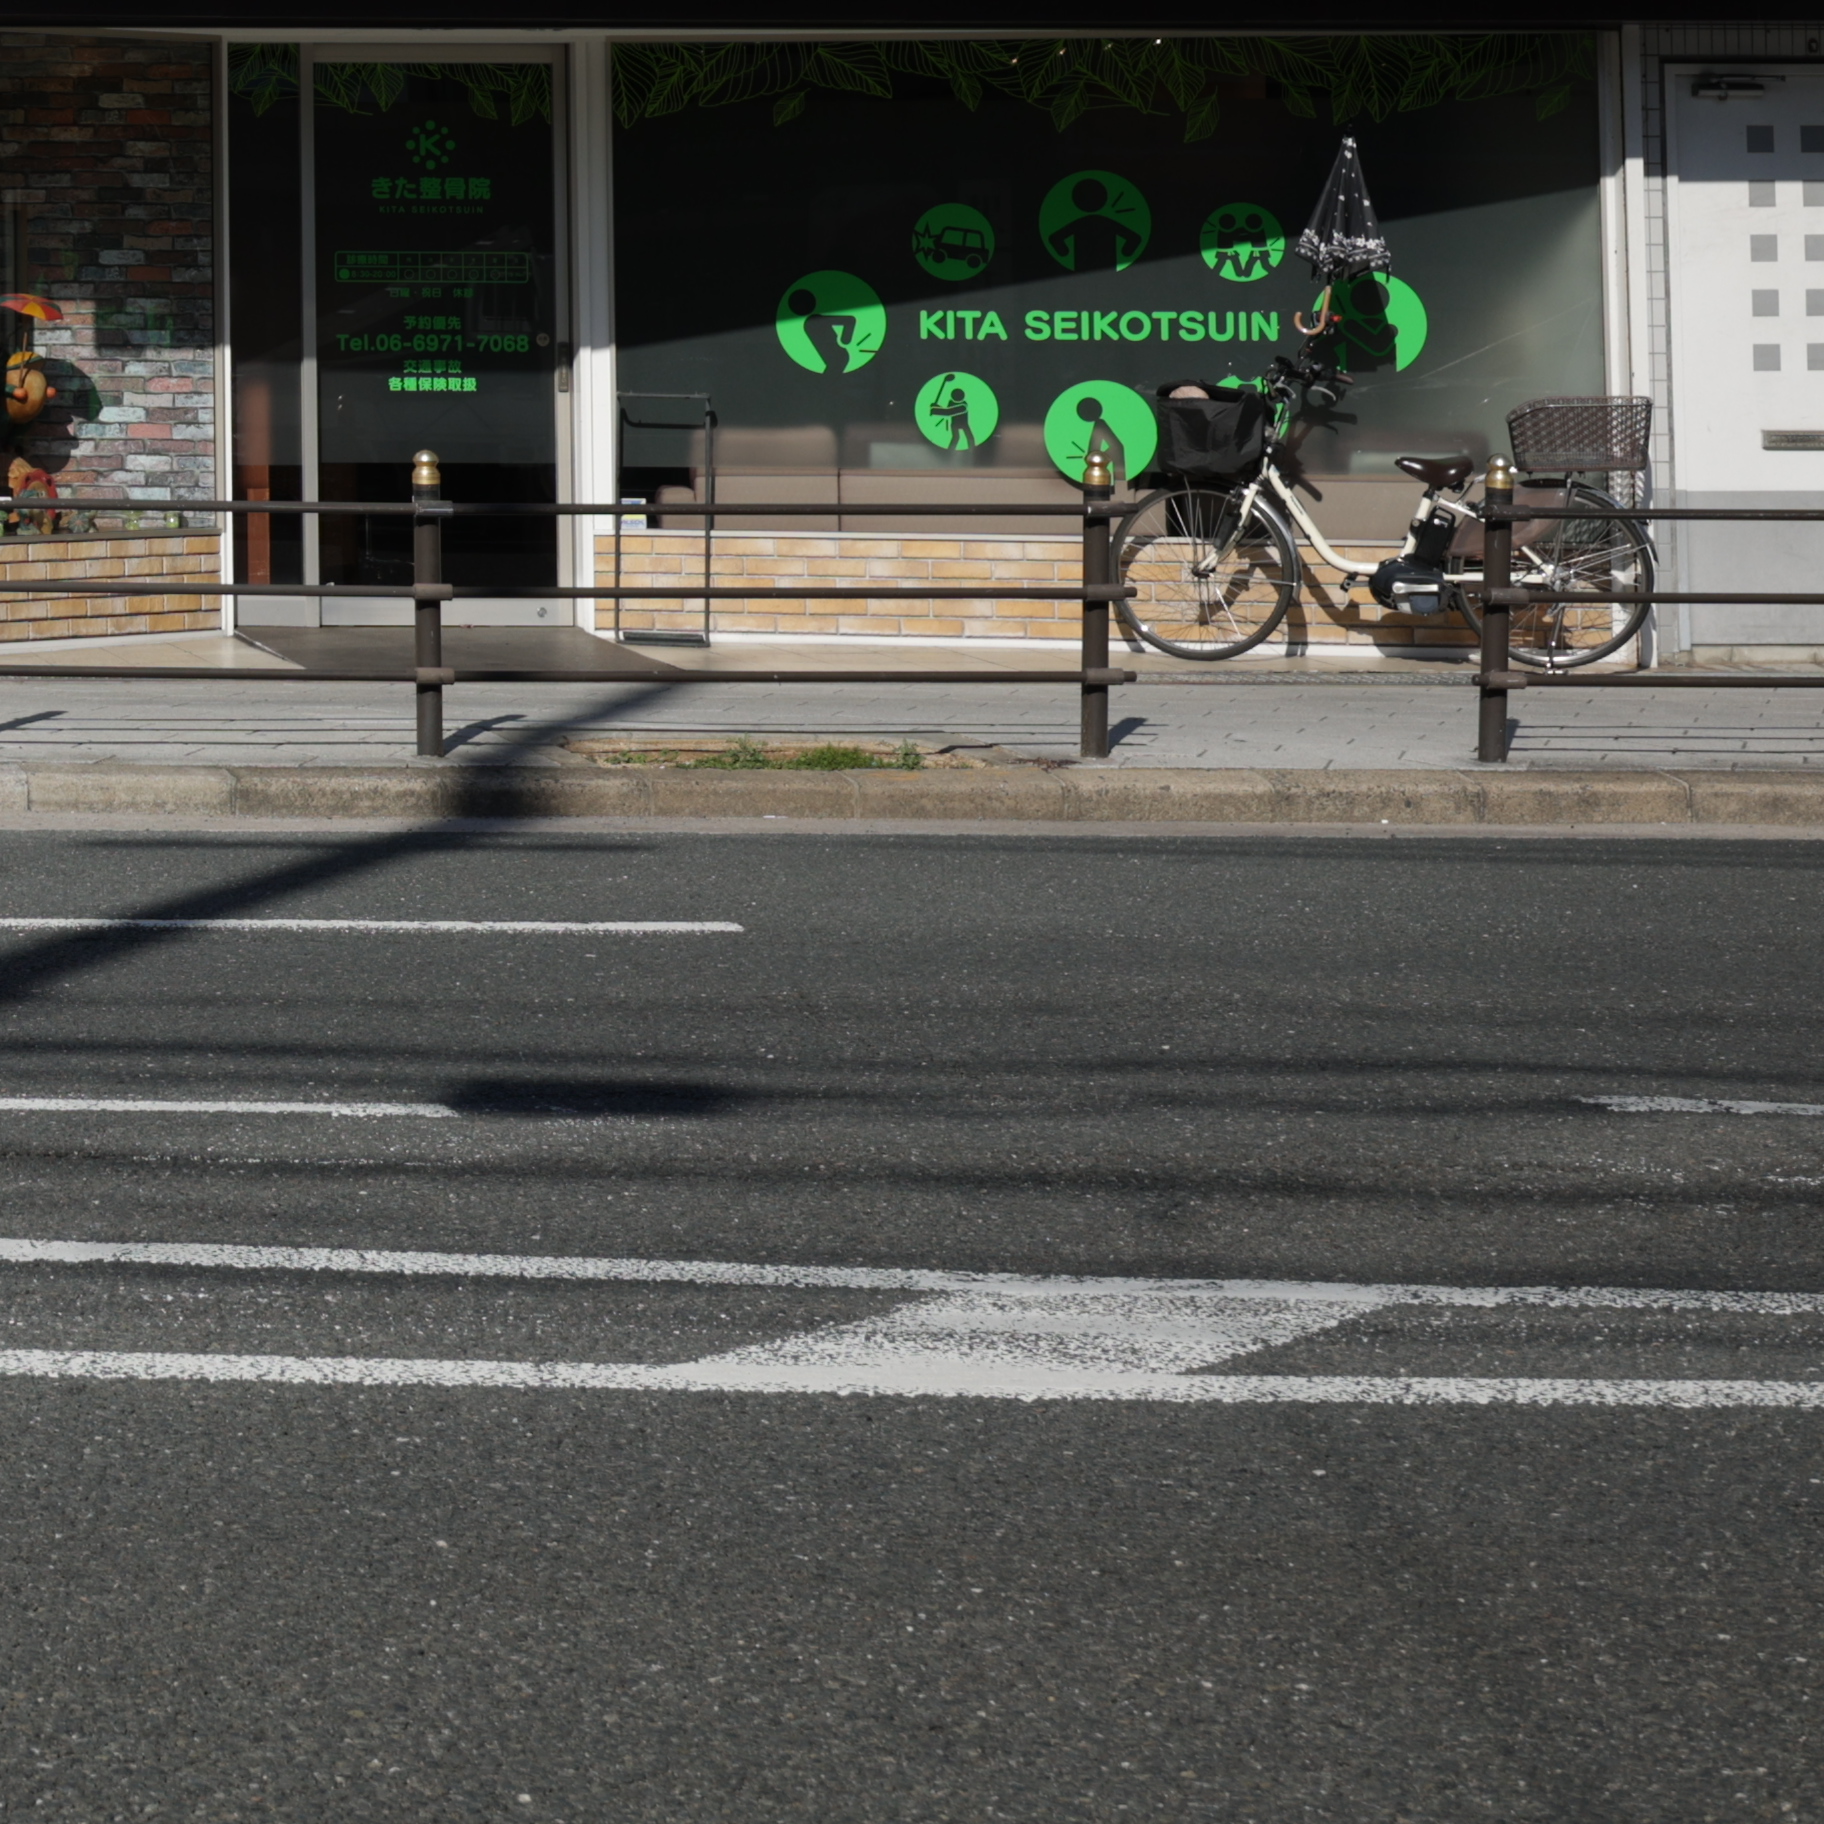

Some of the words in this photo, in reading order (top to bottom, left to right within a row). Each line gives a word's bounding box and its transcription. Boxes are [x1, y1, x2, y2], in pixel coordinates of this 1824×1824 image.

[371, 177, 492, 201] きた整骨院
[379, 205, 406, 214] KITA
[411, 205, 484, 214] SEIKOTSUIN
[919, 309, 1008, 342] KITA
[1024, 309, 1280, 342] SEIKOTSUIN
[335, 333, 530, 353] Tel.06-6971-7068
[403, 359, 463, 374] 交通事故
[388, 376, 478, 393] 各種保険取扱
